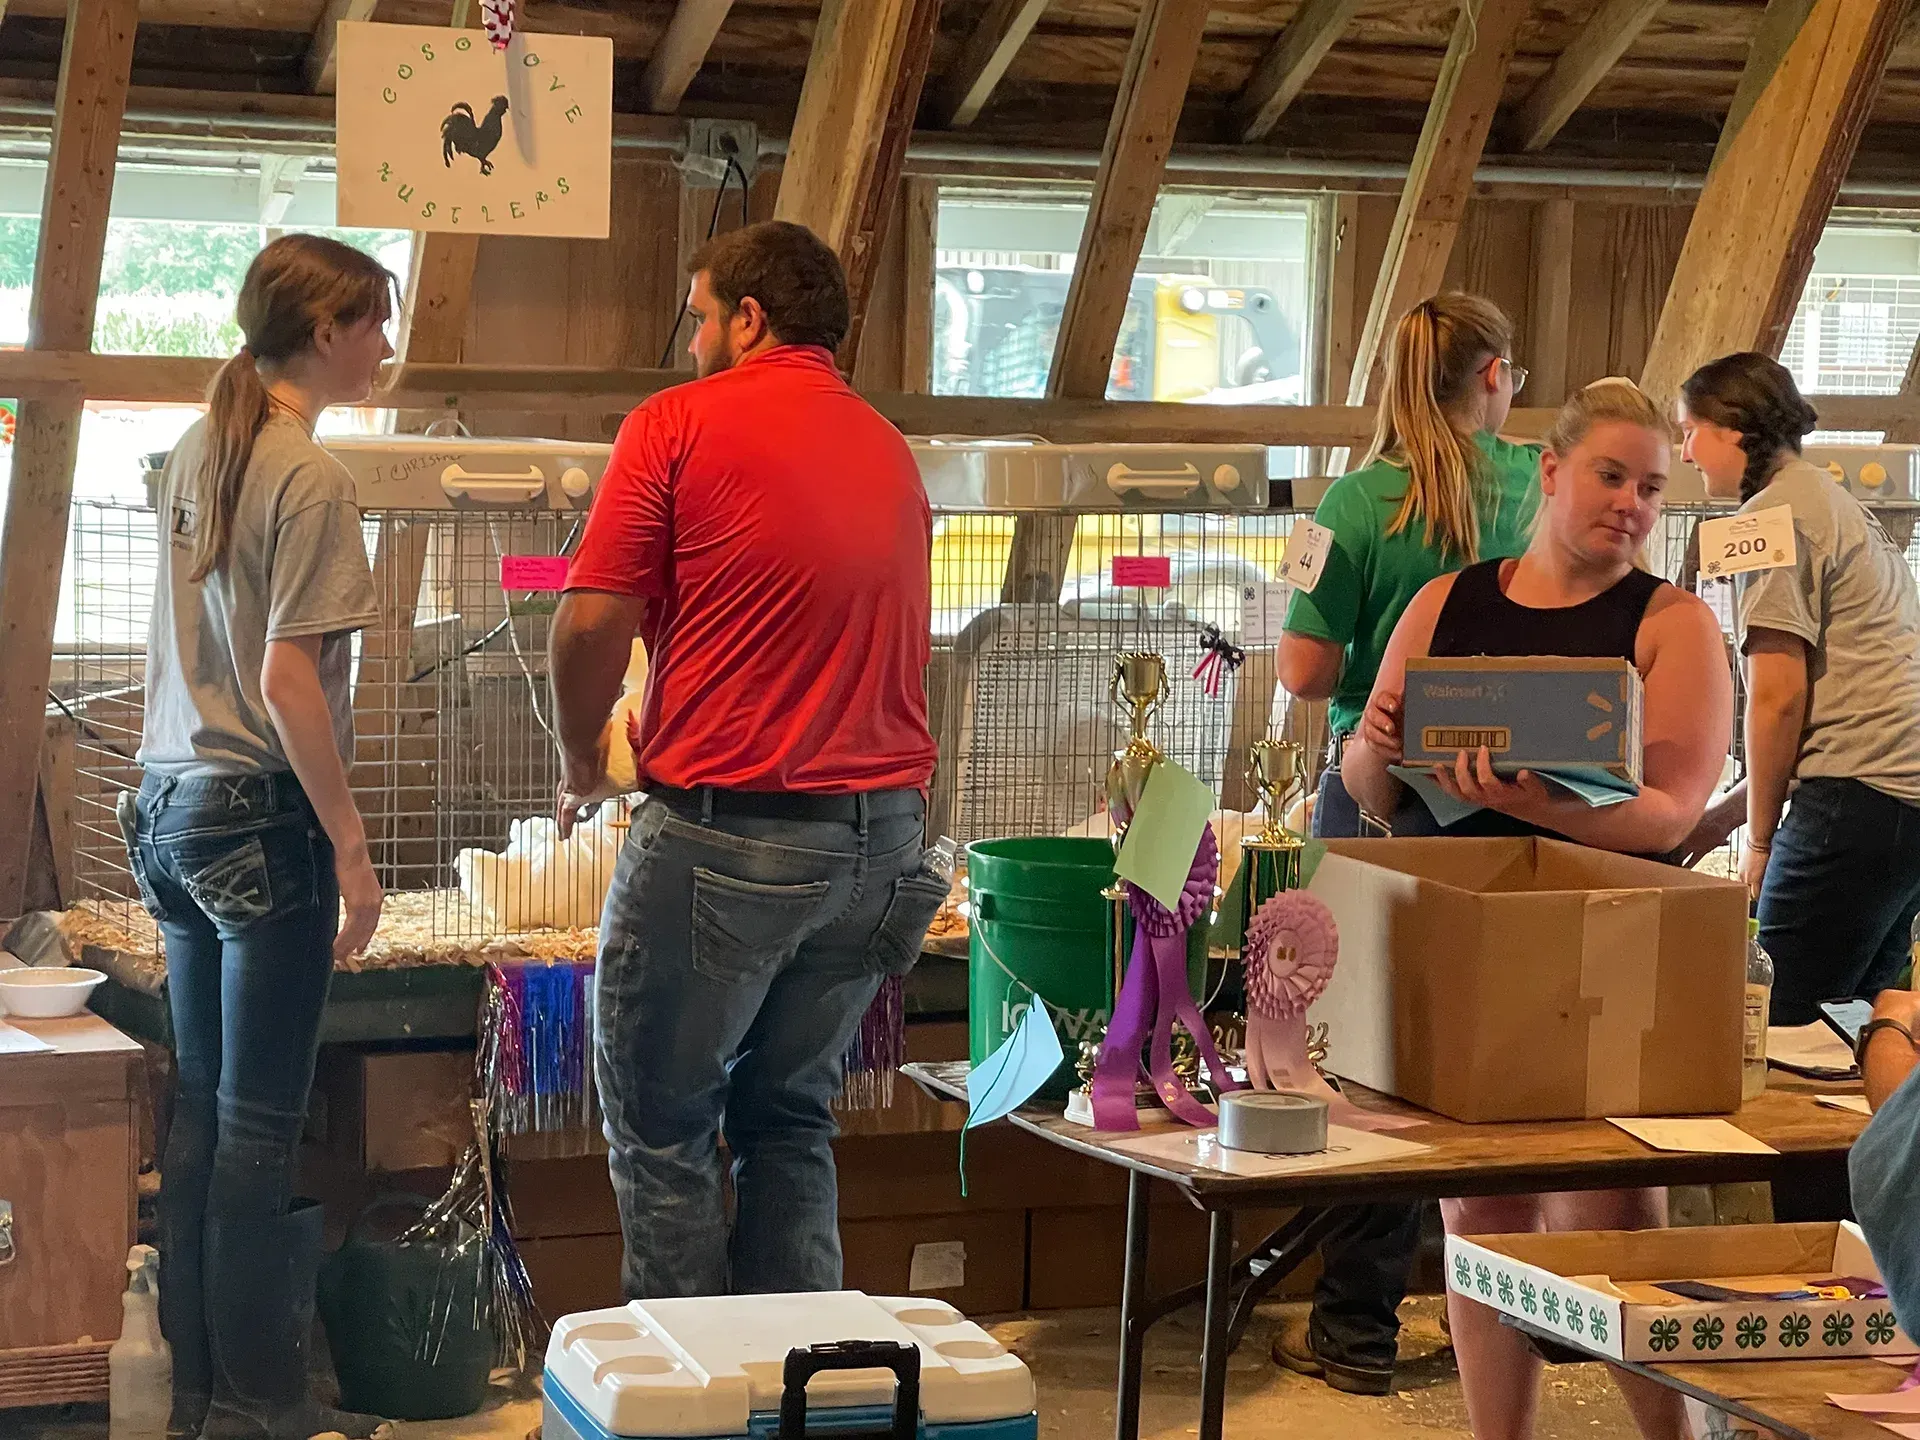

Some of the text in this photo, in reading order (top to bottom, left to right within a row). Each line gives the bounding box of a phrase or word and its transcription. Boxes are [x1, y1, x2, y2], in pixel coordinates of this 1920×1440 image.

[1724, 537, 1767, 559] 200
[1299, 552, 1313, 570] 44
[1423, 684, 1483, 699] Walmart
